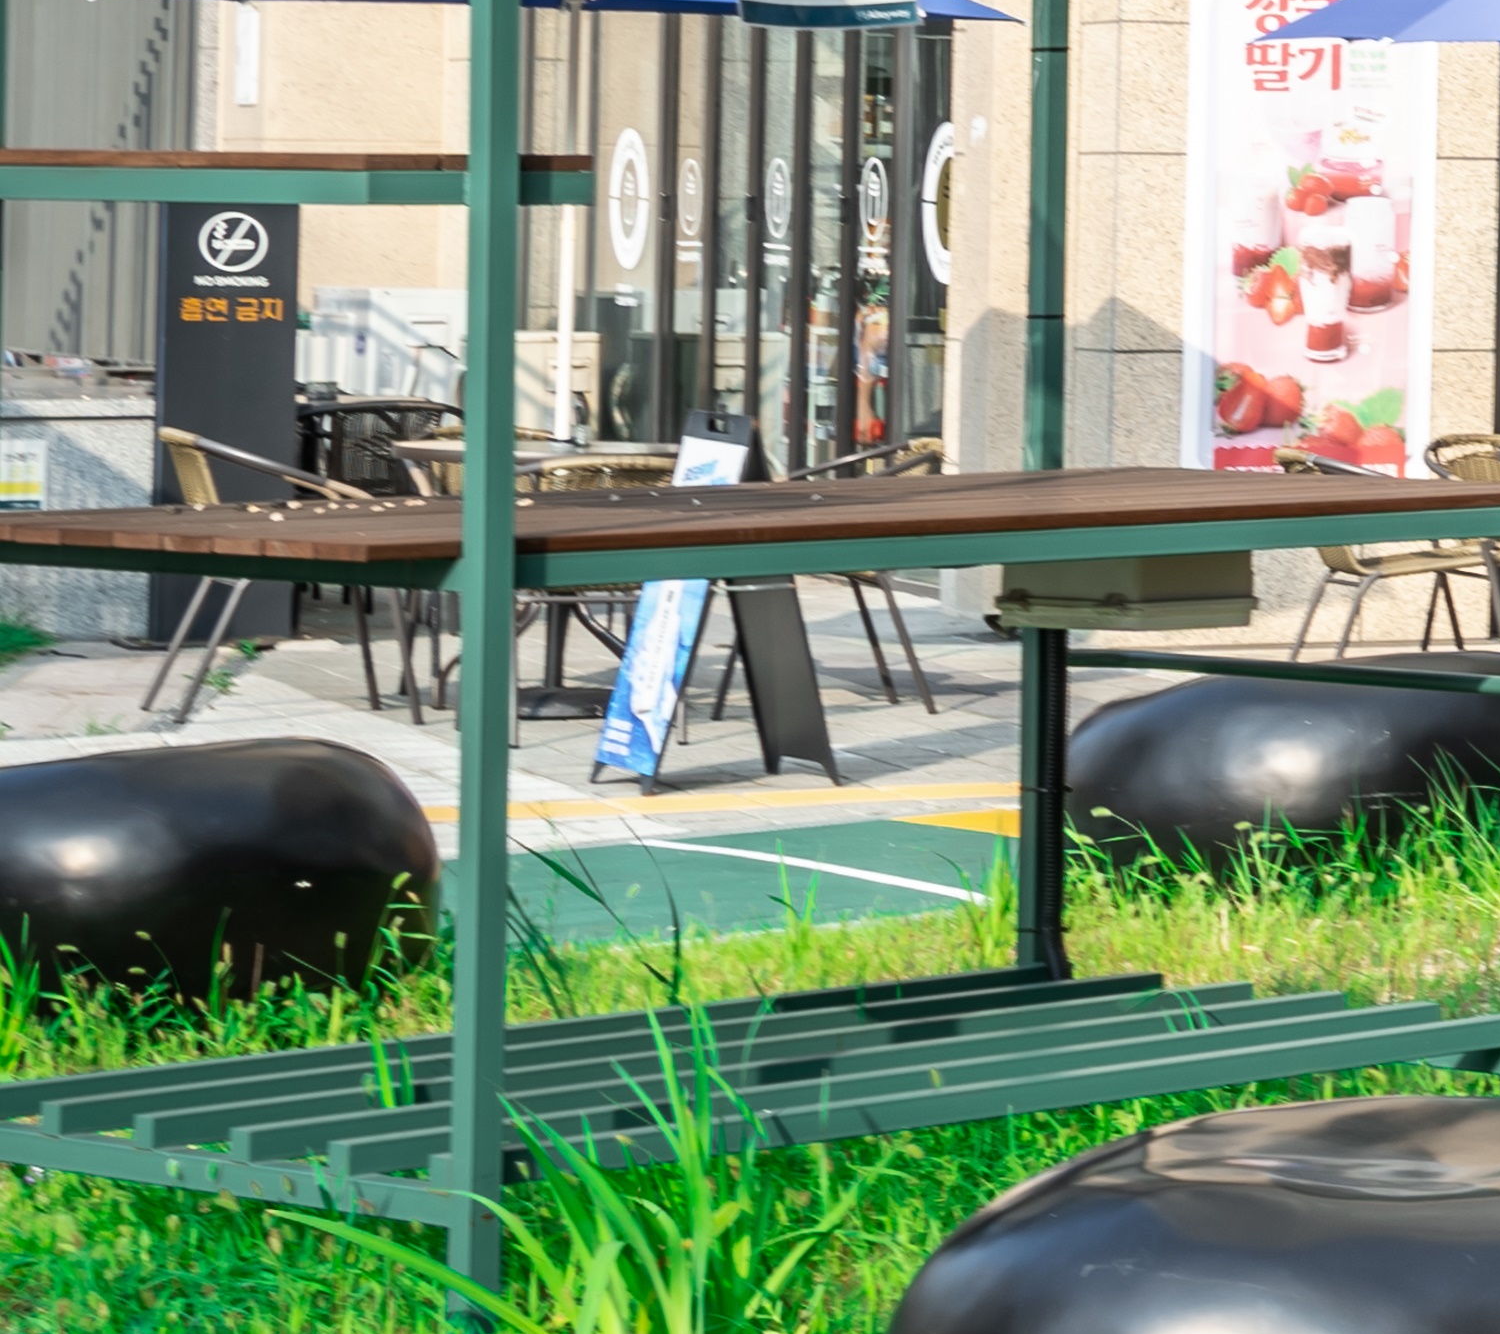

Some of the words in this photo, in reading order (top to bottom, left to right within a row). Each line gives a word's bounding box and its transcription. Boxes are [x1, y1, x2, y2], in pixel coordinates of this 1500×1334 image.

[1245, 42, 1343, 92] 딸기
[180, 296, 229, 322] 흡연
[235, 296, 284, 322] 금지
